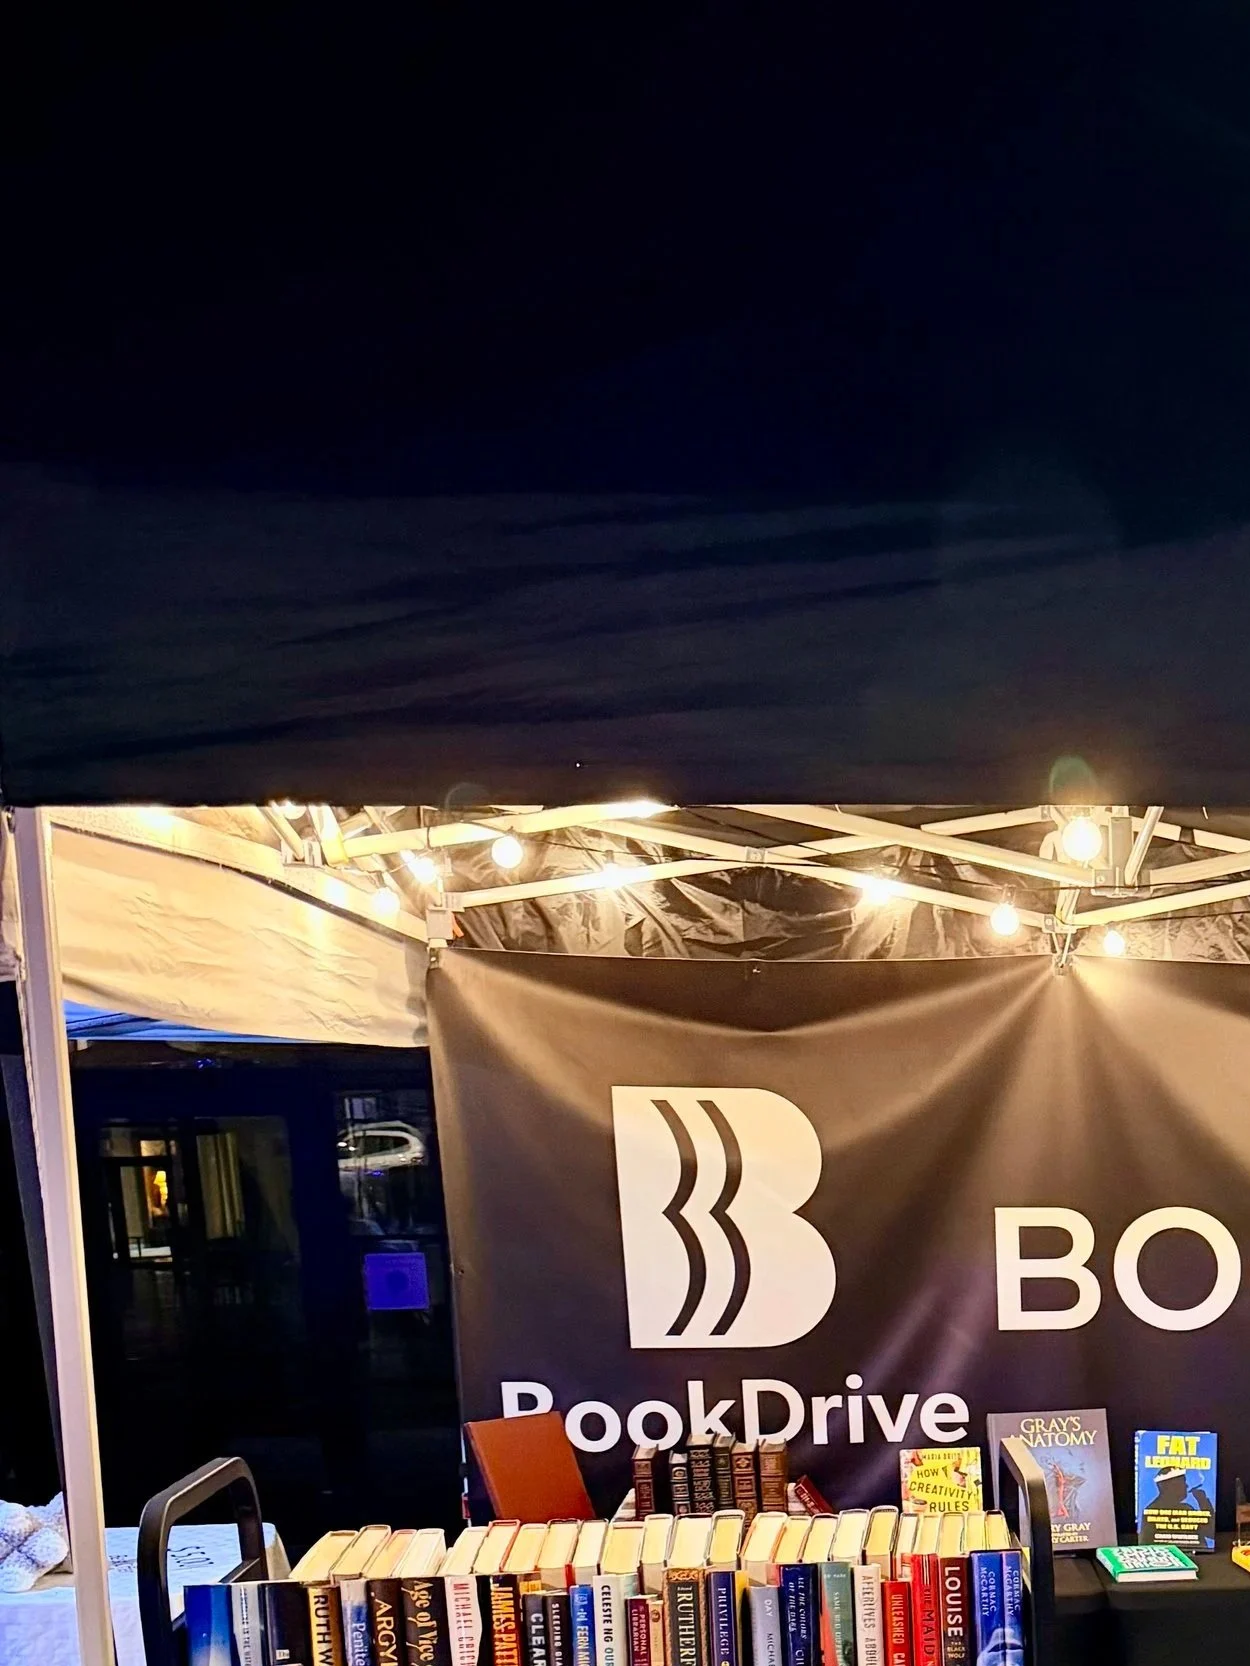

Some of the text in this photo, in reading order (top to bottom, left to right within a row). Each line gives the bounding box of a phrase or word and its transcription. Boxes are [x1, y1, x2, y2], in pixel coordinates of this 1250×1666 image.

[1010, 1430, 1097, 1448] NATOMY
[1020, 1416, 1081, 1434] GRAY'S
[1157, 1435, 1200, 1455] FAT
[916, 1468, 939, 1478] HOW
[1145, 1456, 1211, 1469] LEONARD
[909, 1481, 973, 1500] CREATIVITY
[929, 1501, 969, 1512] RULES
[1063, 1523, 1091, 1535] GRAY
[601, 1586, 613, 1625] CELESTE
[944, 1566, 963, 1637] LOUISE
[980, 1567, 989, 1617] McCARTHY
[987, 1571, 996, 1612] CORMAC
[1005, 1566, 1014, 1616] McCARTHY
[1012, 1570, 1021, 1611] CORMAC
[313, 1595, 329, 1644] RUTH
[454, 1583, 475, 1630] MICHAEL
[491, 1583, 515, 1630] JAMES
[717, 1587, 729, 1655] PRIVILEGE
[764, 1599, 773, 1617] DAY
[577, 1626, 590, 1649] FERN
[603, 1628, 613, 1642] NG
[632, 1609, 640, 1651] LIBRARIAN
